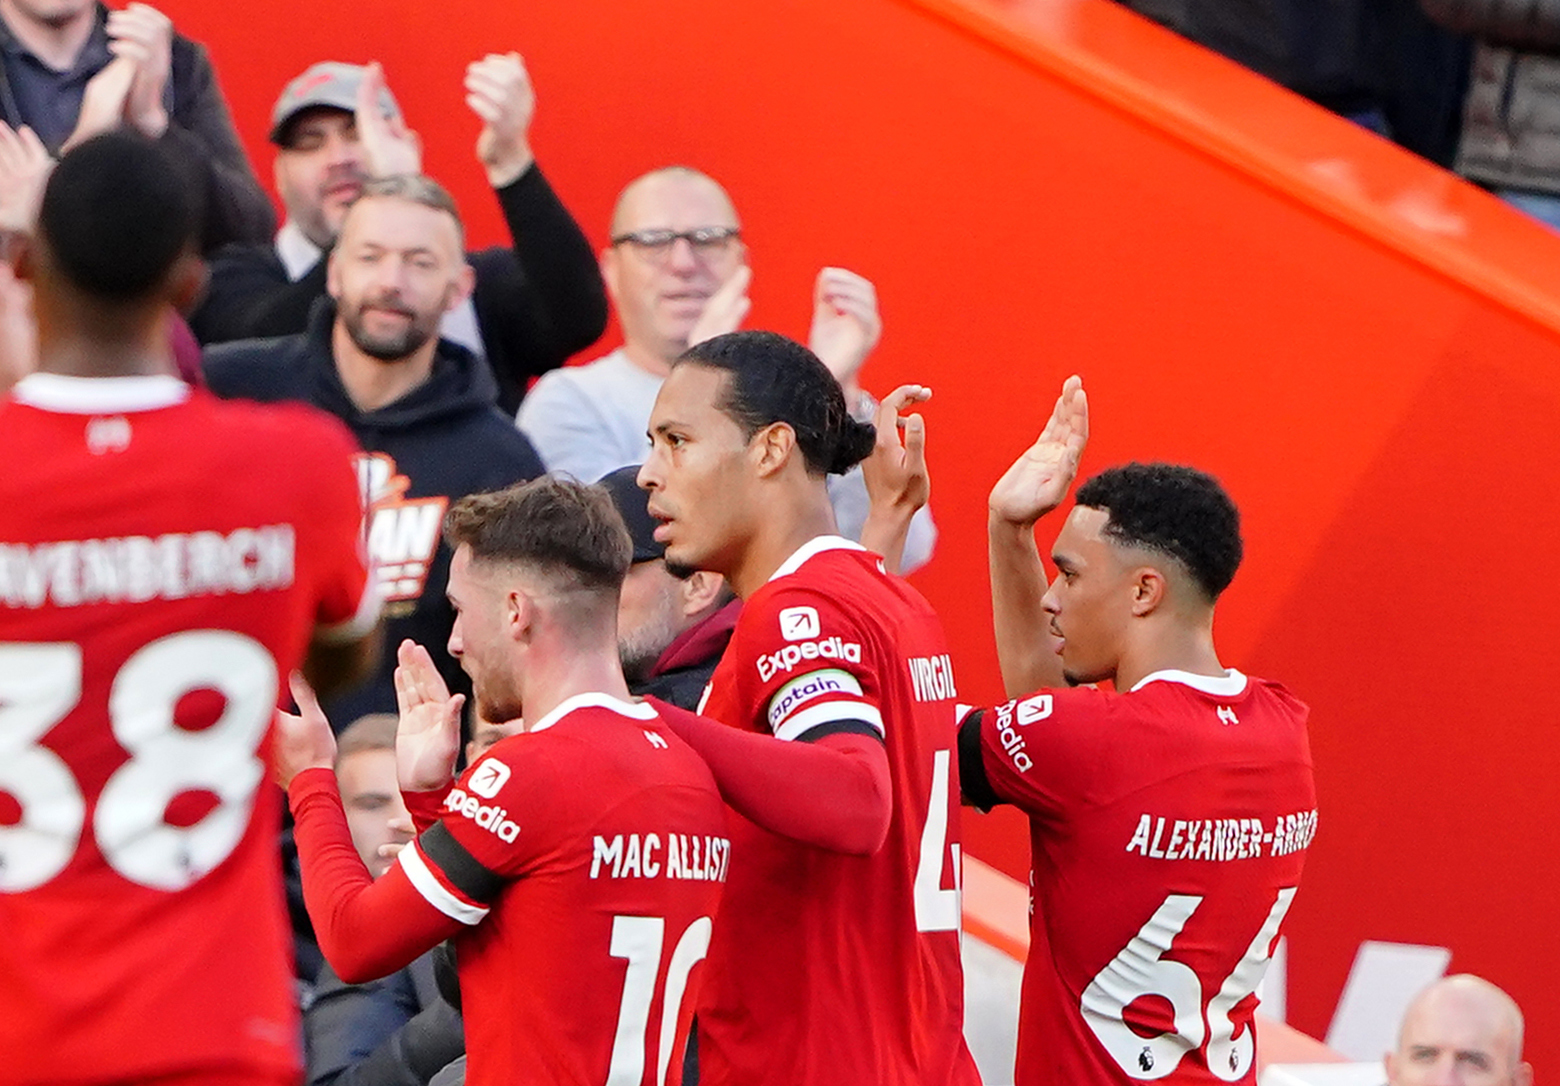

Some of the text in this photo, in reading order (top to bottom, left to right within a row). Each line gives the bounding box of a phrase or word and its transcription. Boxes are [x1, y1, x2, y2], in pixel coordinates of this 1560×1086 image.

[756, 636, 861, 683] Expedia
[908, 654, 957, 701] VIRGIL
[994, 699, 1033, 773] pedia
[443, 788, 521, 844] pedia
[590, 833, 731, 882] MAC ALLIST
